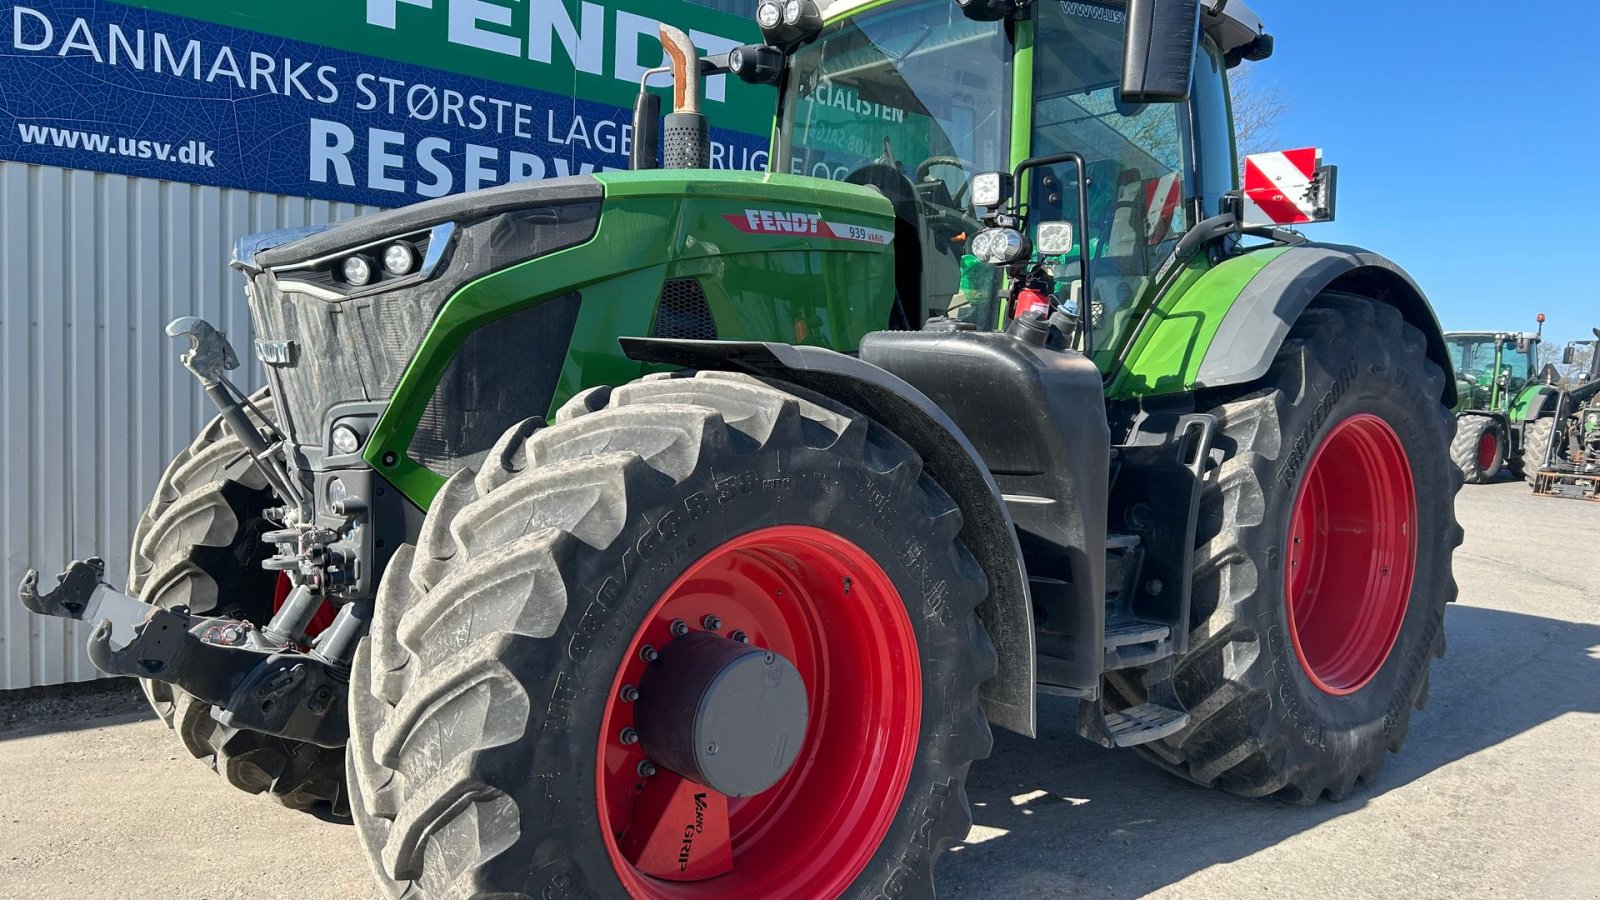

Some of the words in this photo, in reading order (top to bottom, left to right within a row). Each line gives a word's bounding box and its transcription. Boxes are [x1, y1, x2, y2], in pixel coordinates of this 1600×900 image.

[13, 5, 339, 103] DANMARKS
[356, 73, 532, 138] STØRSTE
[547, 109, 632, 156] LAGE
[18, 122, 215, 168] www.usv.dk
[744, 208, 823, 234] FENDT
[849, 226, 866, 239] 939
[867, 232, 885, 243] VARIO
[693, 792, 707, 834] VARIO
[677, 824, 695, 872] GRIP
